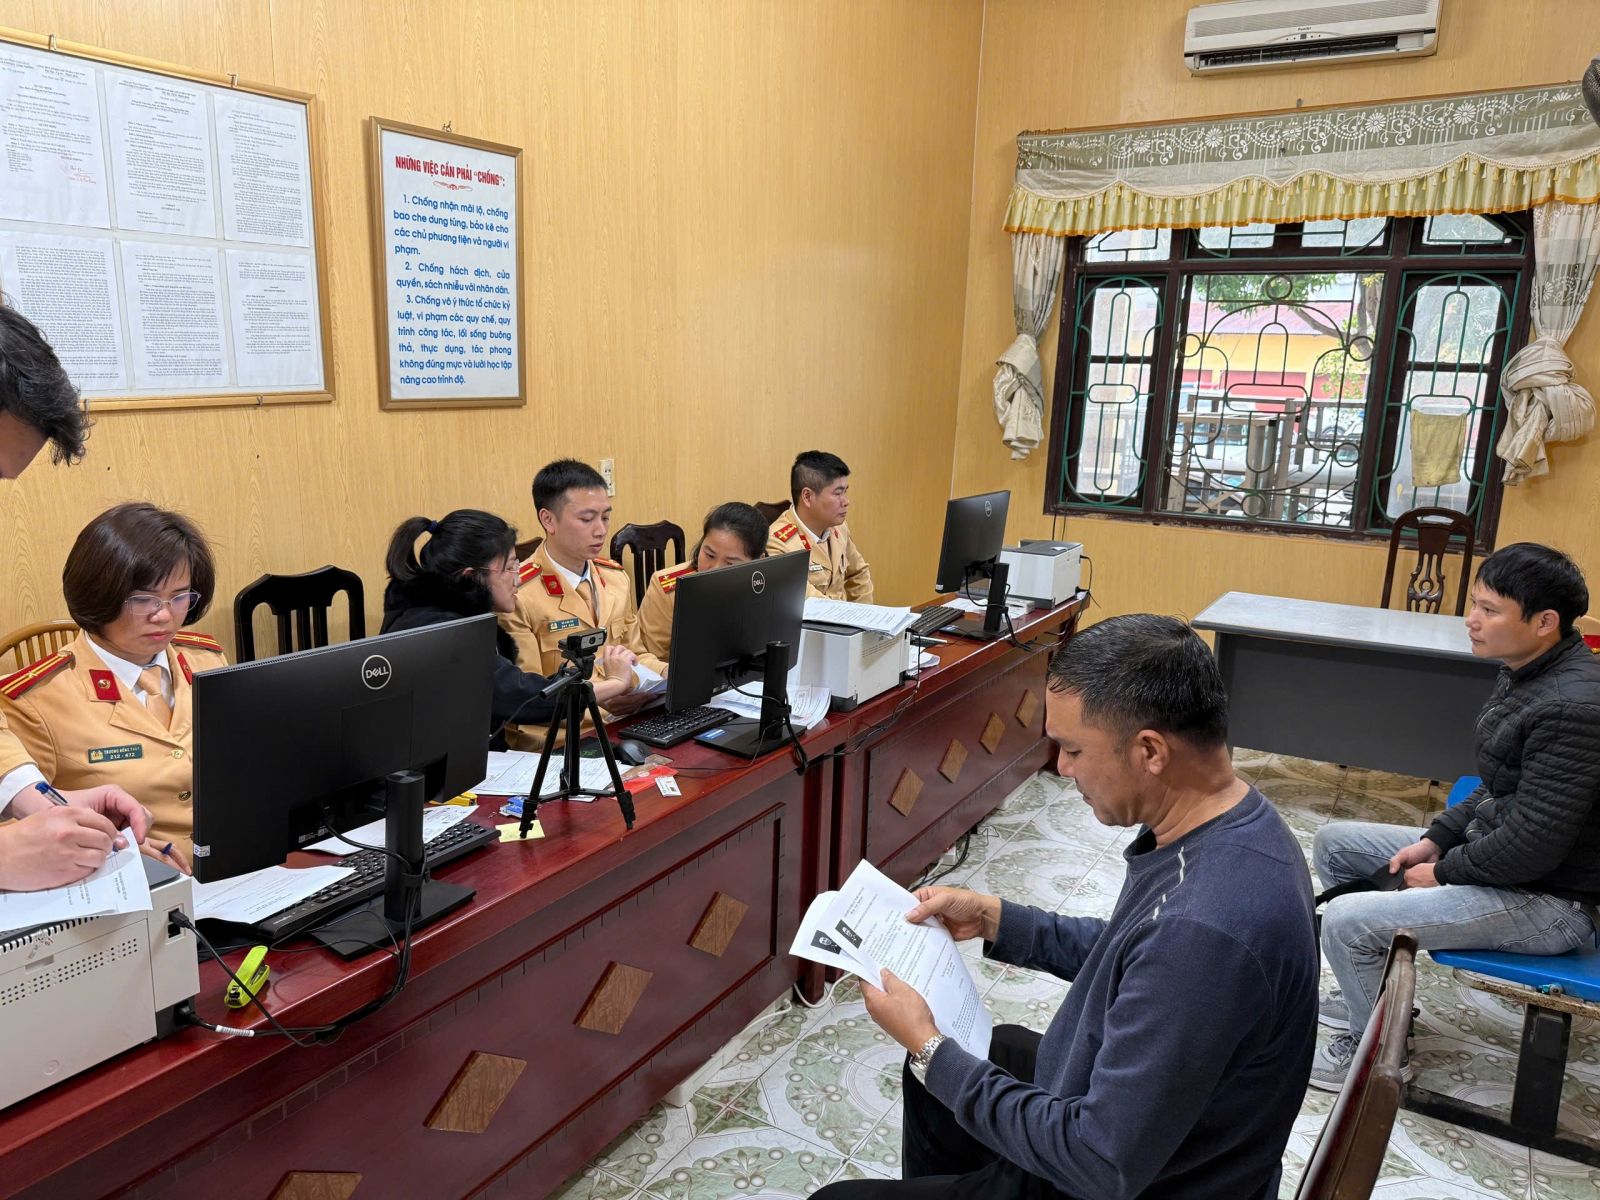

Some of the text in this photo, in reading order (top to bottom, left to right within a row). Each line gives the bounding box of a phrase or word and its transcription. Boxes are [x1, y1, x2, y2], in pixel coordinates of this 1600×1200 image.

[423, 160, 438, 177] VIỆC
[457, 164, 472, 180] PHẢI
[403, 195, 409, 204] 1.
[412, 196, 438, 210] Chống
[440, 201, 458, 212] nhận
[487, 208, 508, 220] chống
[394, 210, 410, 220] bao
[412, 213, 427, 222] che
[429, 215, 448, 227] dung
[496, 225, 509, 233] cho
[394, 228, 410, 236] các
[412, 229, 427, 239] chủ
[428, 231, 457, 244] phương
[458, 235, 471, 245] tiện
[483, 238, 502, 248] người
[395, 245, 420, 256] phạm.
[405, 262, 412, 270] 2.
[418, 263, 444, 275] Chống
[450, 265, 468, 275] hách
[425, 280, 442, 289] sách
[406, 295, 413, 303] 3.
[415, 295, 440, 307] Chống
[453, 297, 457, 307] ý
[503, 300, 510, 310] kỷ
[398, 311, 414, 320] luật,
[426, 313, 447, 322] phạm
[467, 315, 479, 323] quy
[498, 317, 511, 325] quy
[418, 329, 438, 338] công
[442, 328, 455, 338] tác,
[470, 329, 486, 340] sống
[490, 331, 511, 340] buông
[399, 343, 414, 352] thả,
[421, 344, 438, 353] thực
[490, 346, 511, 355] phong
[400, 360, 424, 370] không
[426, 360, 445, 370] đúng
[487, 361, 500, 370] học
[501, 361, 512, 370] tập
[400, 376, 420, 385] nâng
[455, 375, 465, 384] độ.
[365, 666, 389, 679] DELL
